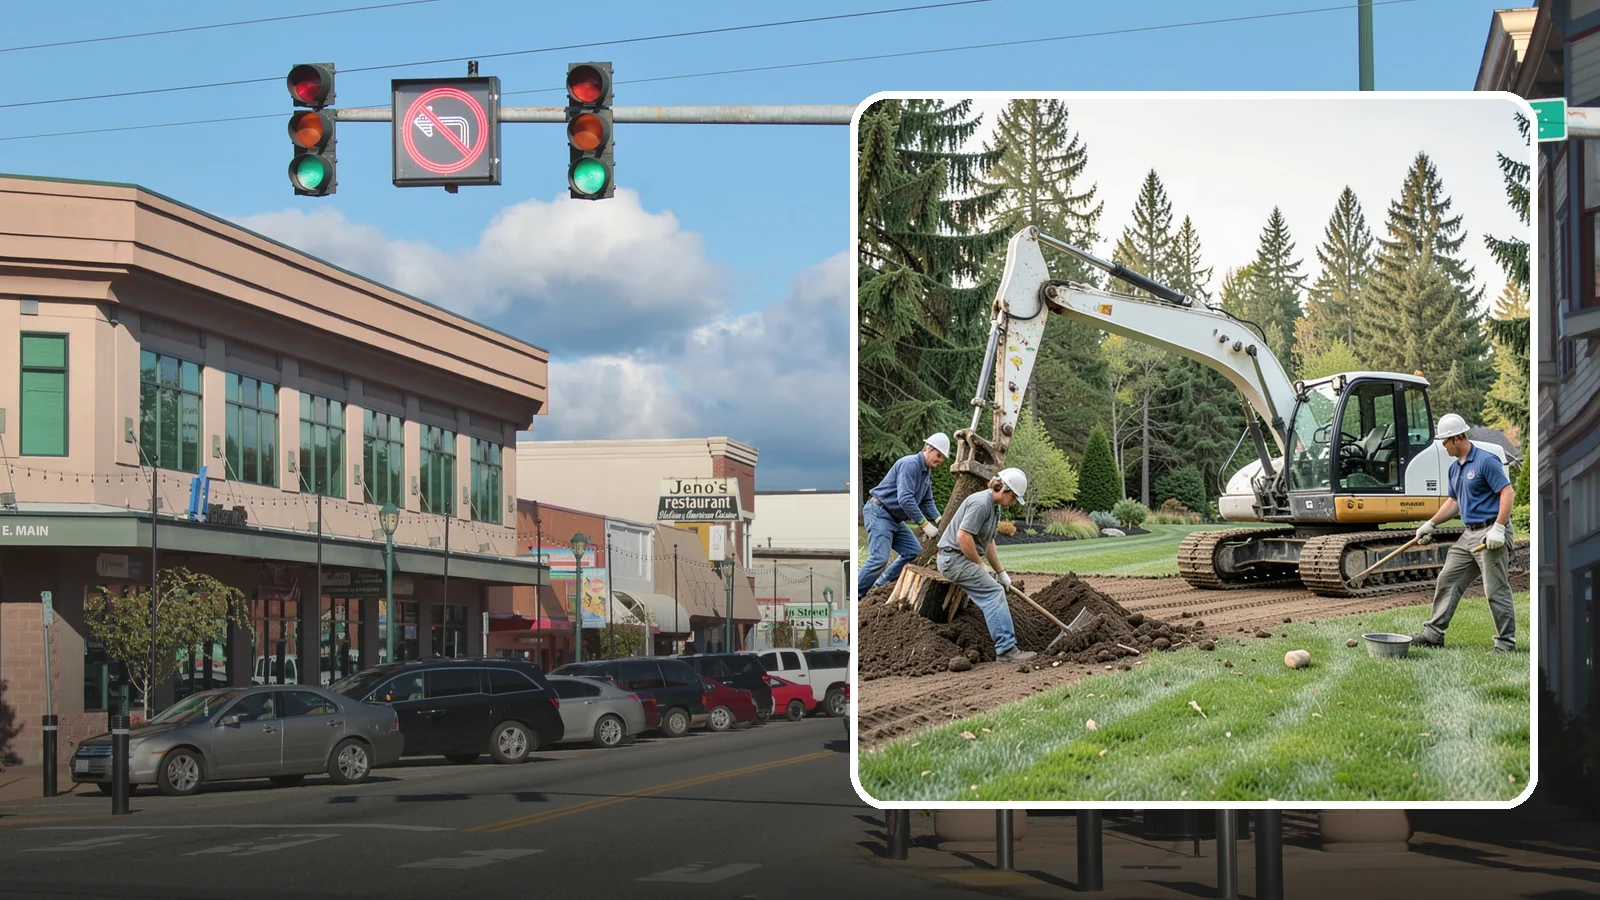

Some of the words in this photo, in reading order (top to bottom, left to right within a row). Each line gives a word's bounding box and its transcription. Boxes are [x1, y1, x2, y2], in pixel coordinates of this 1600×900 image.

[669, 480, 728, 495] Jeno's
[665, 496, 731, 509] restaurant
[658, 510, 681, 520] Italian
[686, 509, 714, 519] American
[715, 509, 737, 519] Cuisine
[2, 525, 13, 536] E.
[15, 525, 49, 536] MAIN
[797, 607, 829, 617] Street
